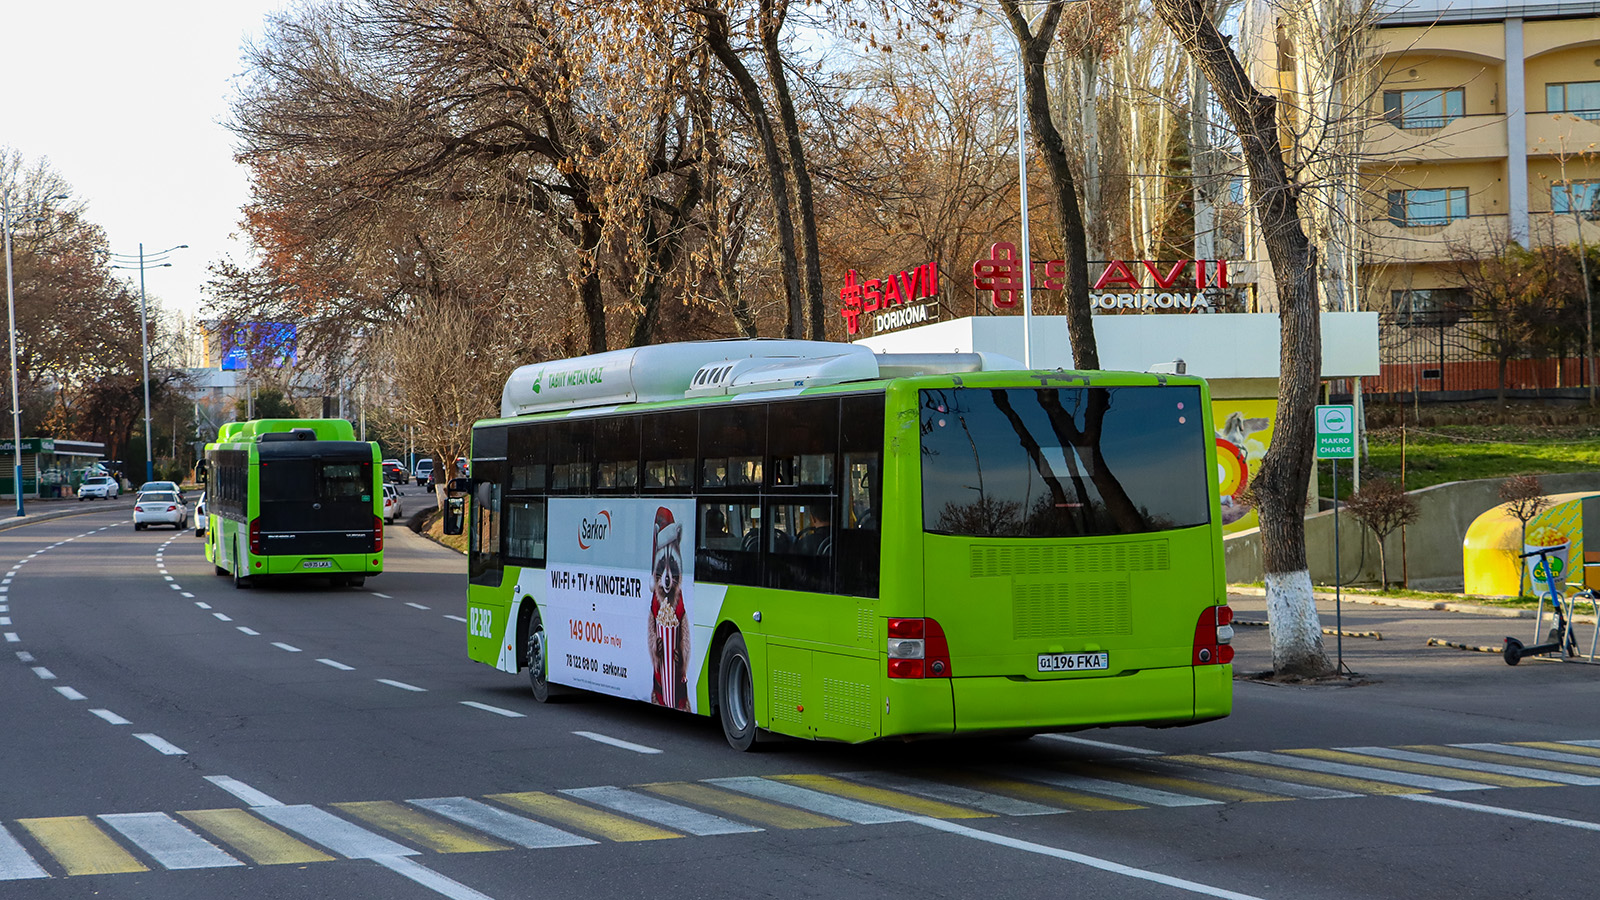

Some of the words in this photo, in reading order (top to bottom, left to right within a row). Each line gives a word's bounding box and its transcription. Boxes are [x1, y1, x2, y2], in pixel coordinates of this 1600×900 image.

[864, 262, 938, 312] SAVII
[876, 304, 928, 332] DORIXONA
[567, 368, 588, 387] METAN
[589, 367, 604, 384] GAZ
[582, 517, 608, 540] Sarkor
[551, 570, 570, 590] WI-FI
[577, 572, 588, 592] TV
[595, 574, 642, 599] KINOTEATR
[470, 607, 479, 636] 02
[479, 608, 492, 639] 382
[569, 618, 583, 641] 149
[585, 621, 603, 644] 000
[573, 654, 581, 669] 122
[590, 658, 599, 673] 00
[602, 660, 628, 679] sarkor.uz
[1040, 658, 1051, 668] 01
[1053, 656, 1074, 669] 196
[1077, 655, 1100, 668] FKA
